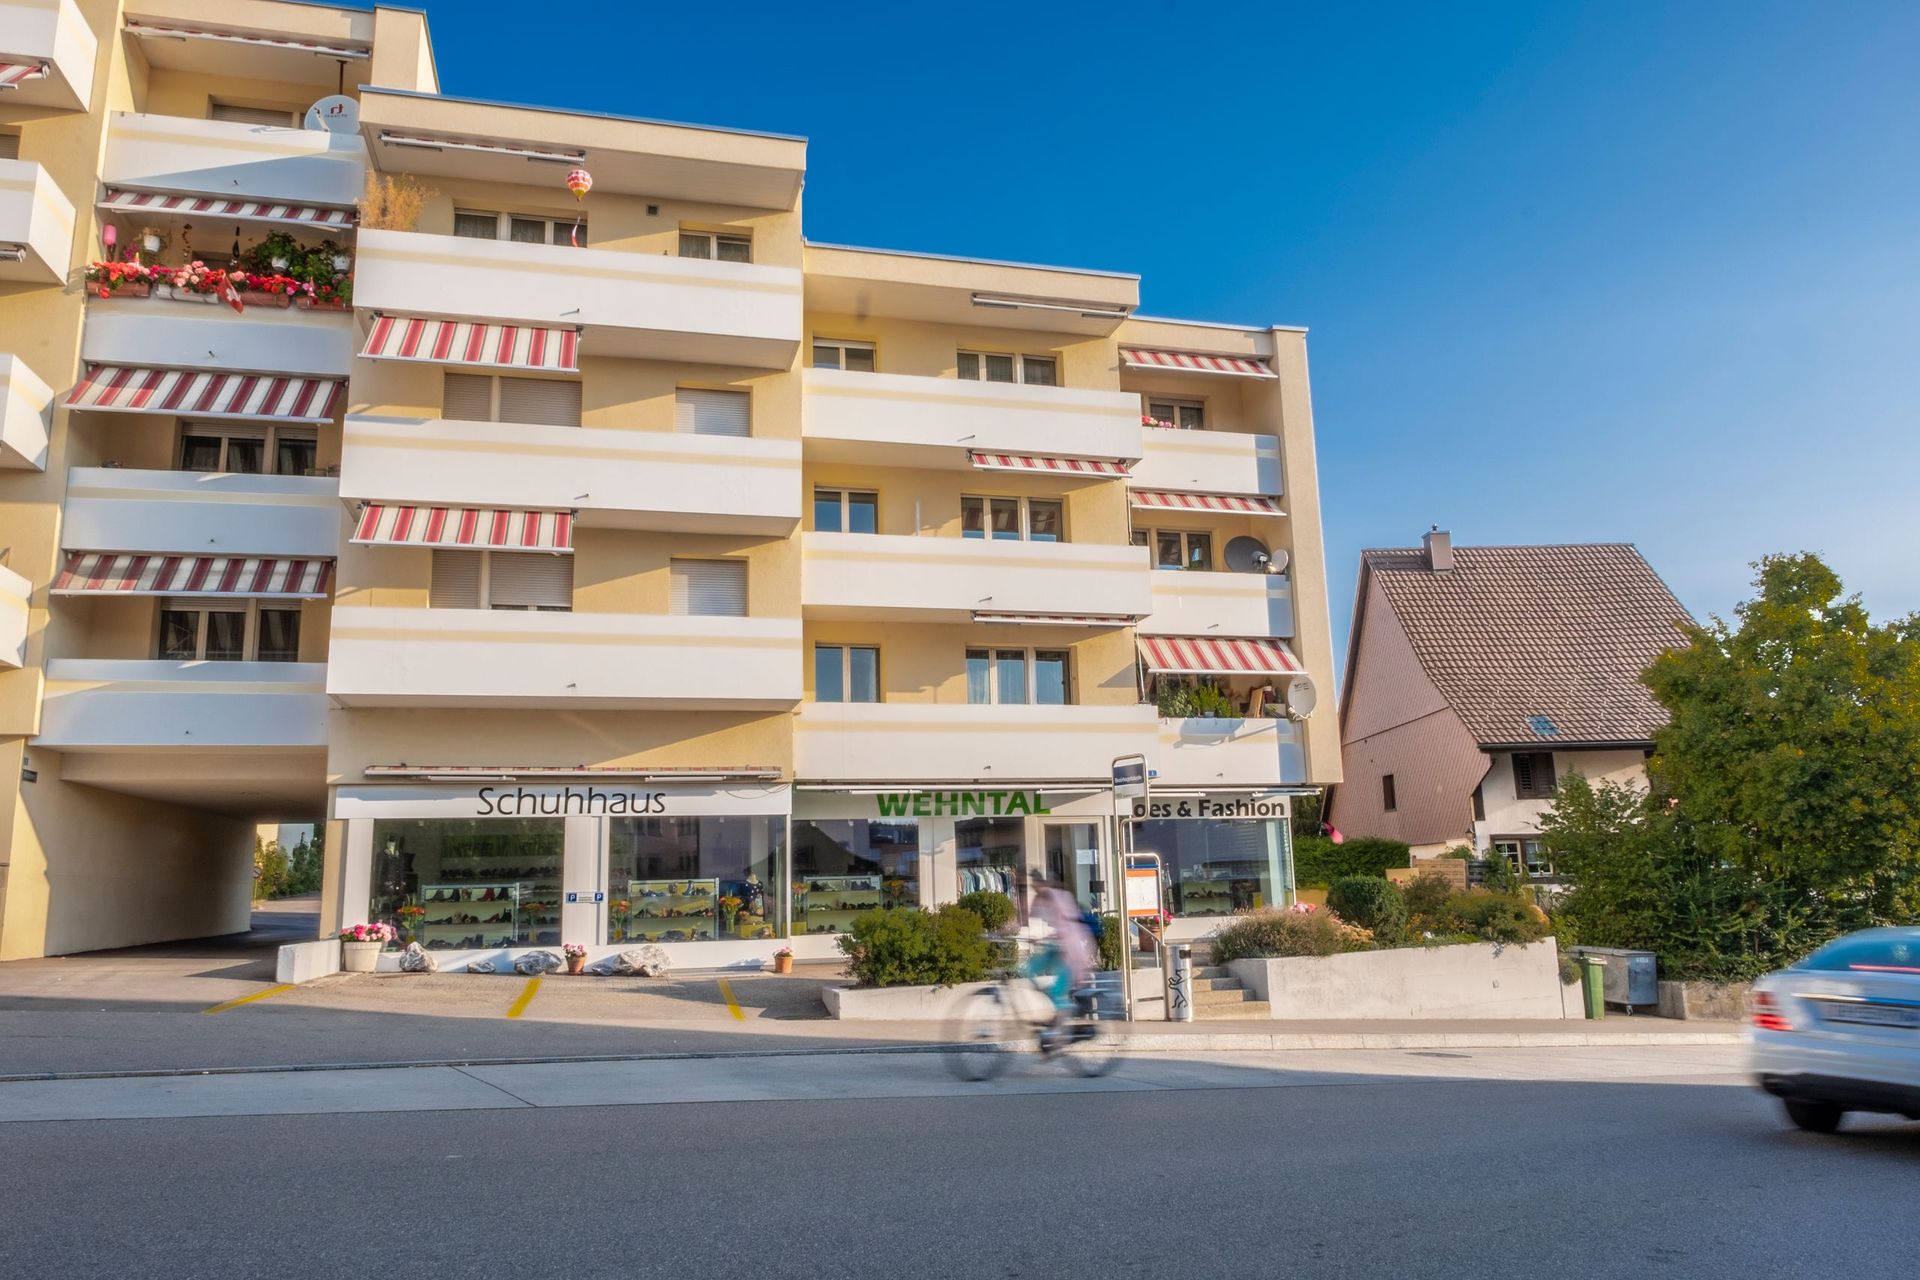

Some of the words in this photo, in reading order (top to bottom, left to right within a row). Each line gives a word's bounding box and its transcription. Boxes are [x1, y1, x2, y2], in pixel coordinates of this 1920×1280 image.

[476, 787, 666, 815] Schuhhaus
[876, 791, 1051, 816] WEHNTAL
[1133, 803, 1171, 818] oes
[1177, 801, 1192, 817] &
[1198, 799, 1285, 818] Fashion
